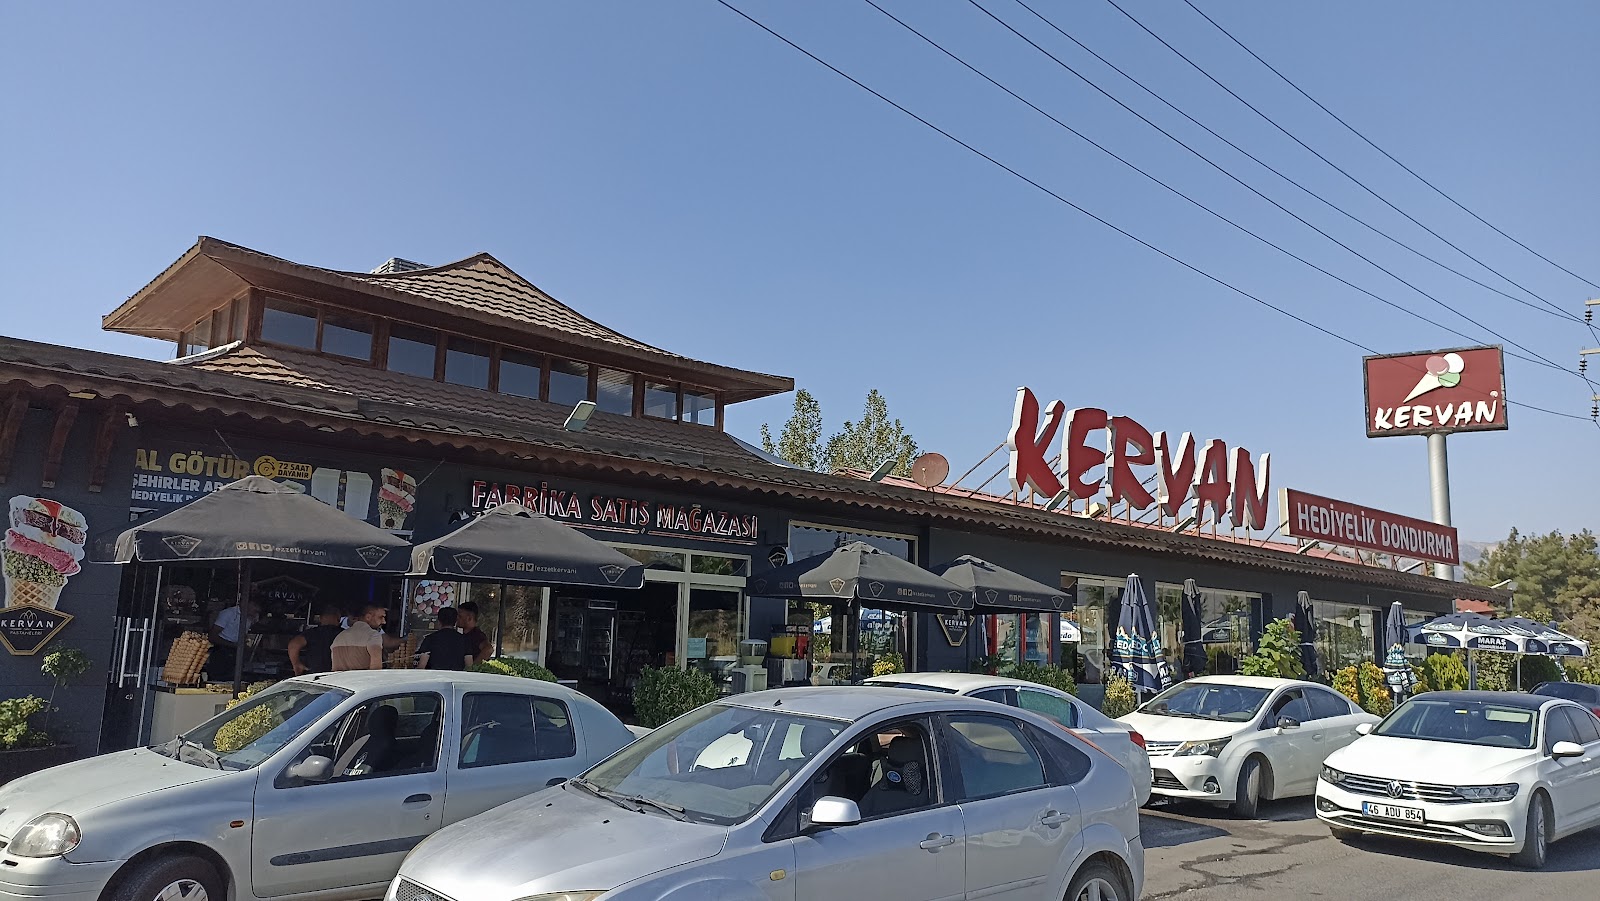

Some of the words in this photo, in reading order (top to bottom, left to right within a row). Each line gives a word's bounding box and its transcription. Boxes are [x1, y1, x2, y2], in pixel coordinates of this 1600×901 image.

[1374, 400, 1497, 430] KERVAN
[134, 449, 162, 472] AL
[168, 450, 250, 479] GÖTÜR
[290, 464, 310, 472] SAAT
[1007, 386, 1271, 530] KERVAN
[277, 470, 309, 479] DAYANIR
[471, 480, 582, 519] FABRİKA
[656, 503, 758, 539] MAĞAZASI
[1297, 502, 1377, 545] HEDİYELİK
[1381, 520, 1454, 560] DONDURMA
[0, 619, 55, 629] KERVAN
[944, 619, 968, 627] KERVAN
[1368, 804, 1379, 815] 46
[1384, 806, 1401, 818] ADU
[1405, 809, 1422, 821] 854
